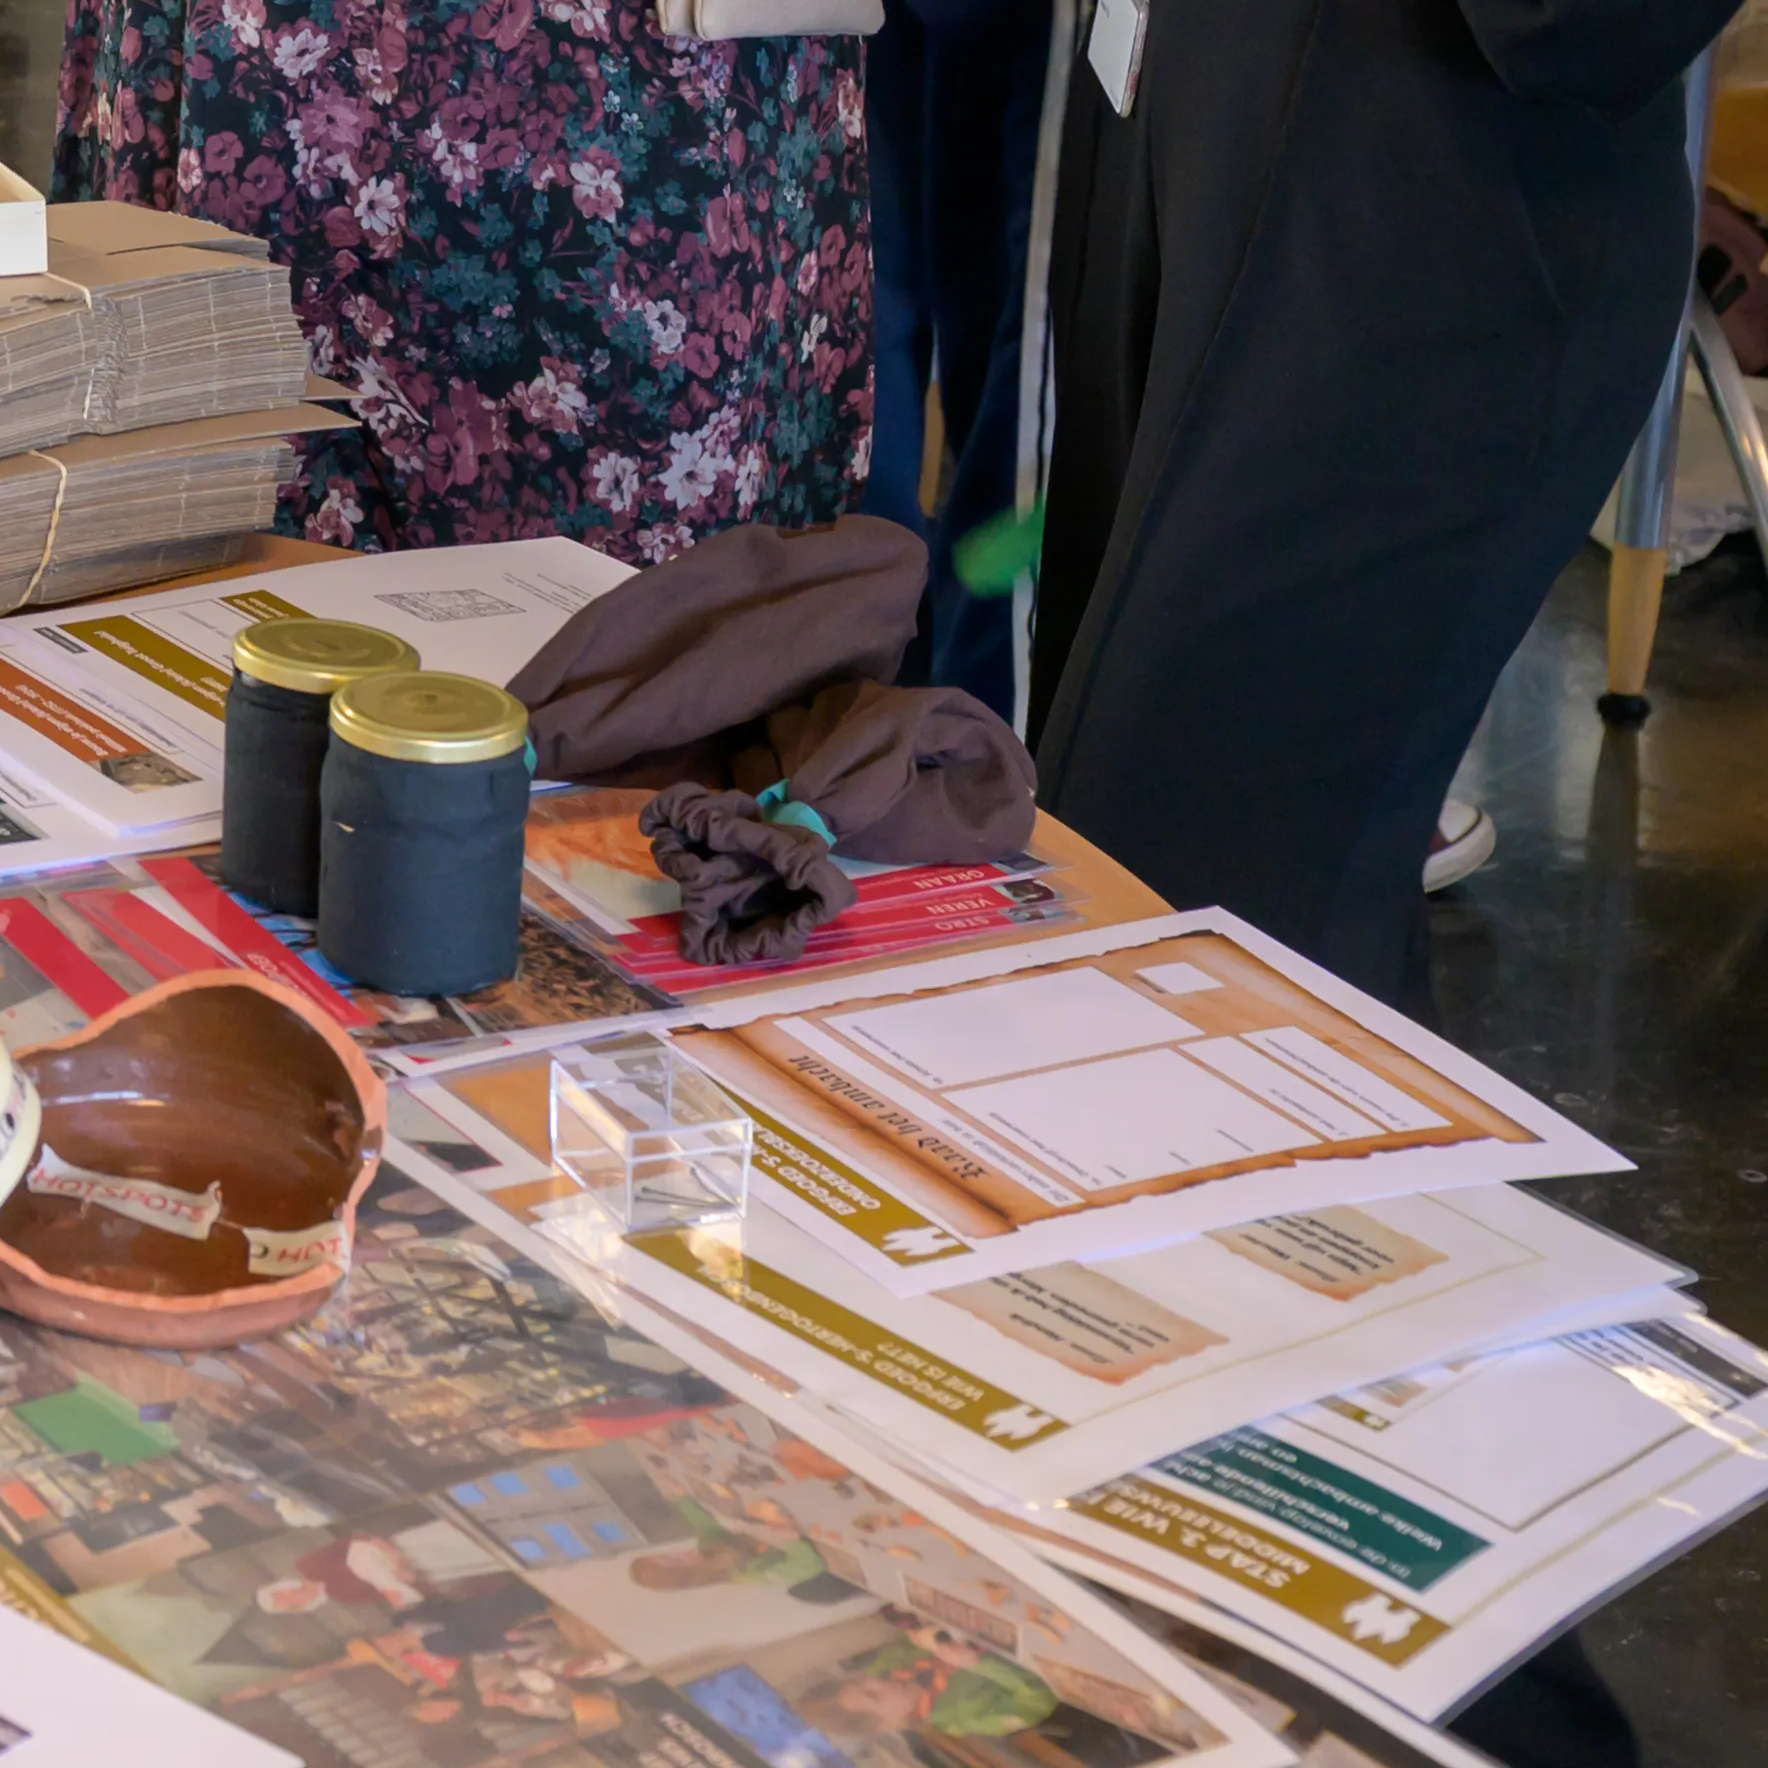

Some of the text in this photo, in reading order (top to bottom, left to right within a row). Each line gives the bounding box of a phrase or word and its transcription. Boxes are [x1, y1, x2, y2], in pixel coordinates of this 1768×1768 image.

[913, 868, 986, 892] GRAAN
[924, 896, 995, 916] VEREN
[933, 915, 991, 932] STRO
[787, 1053, 989, 1179] Raad het ambacht
[33, 1168, 208, 1222] HOTSPOTS
[776, 1164, 858, 1216] ERFGOED
[278, 1237, 344, 1264] HOT
[872, 1338, 925, 1368] HET?
[870, 1357, 966, 1411] ERFGOED
[936, 1371, 985, 1401] WIE
[1213, 1462, 1351, 1530] verschillende
[1235, 1445, 1380, 1516] ambachtsman
[1101, 1493, 1171, 1535] WIE
[1277, 1506, 1359, 1548] envelop
[1378, 1512, 1444, 1549] Welke
[1200, 1537, 1292, 1589] STAP
